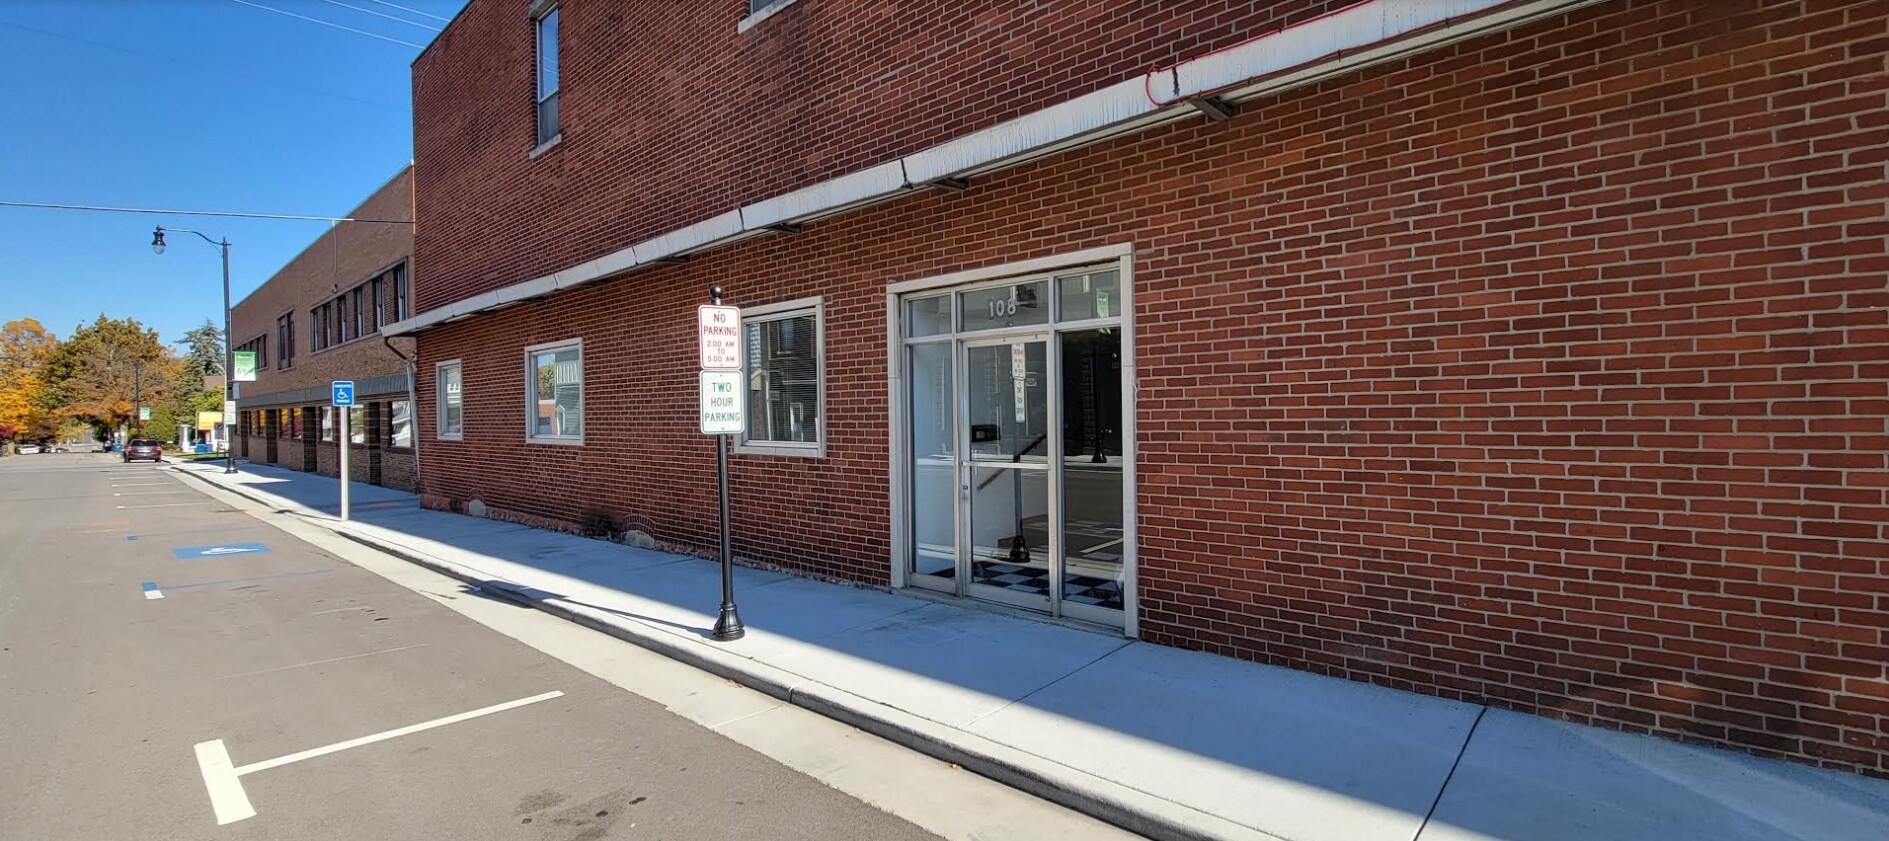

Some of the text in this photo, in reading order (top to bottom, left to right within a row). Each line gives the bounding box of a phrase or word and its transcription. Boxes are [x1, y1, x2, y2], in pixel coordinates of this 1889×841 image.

[989, 299, 1016, 317] 108
[713, 313, 726, 323] NO
[703, 325, 737, 336] PARKING
[711, 382, 732, 392] TWO
[711, 397, 733, 407] HOUR
[704, 412, 740, 422] PARKING
